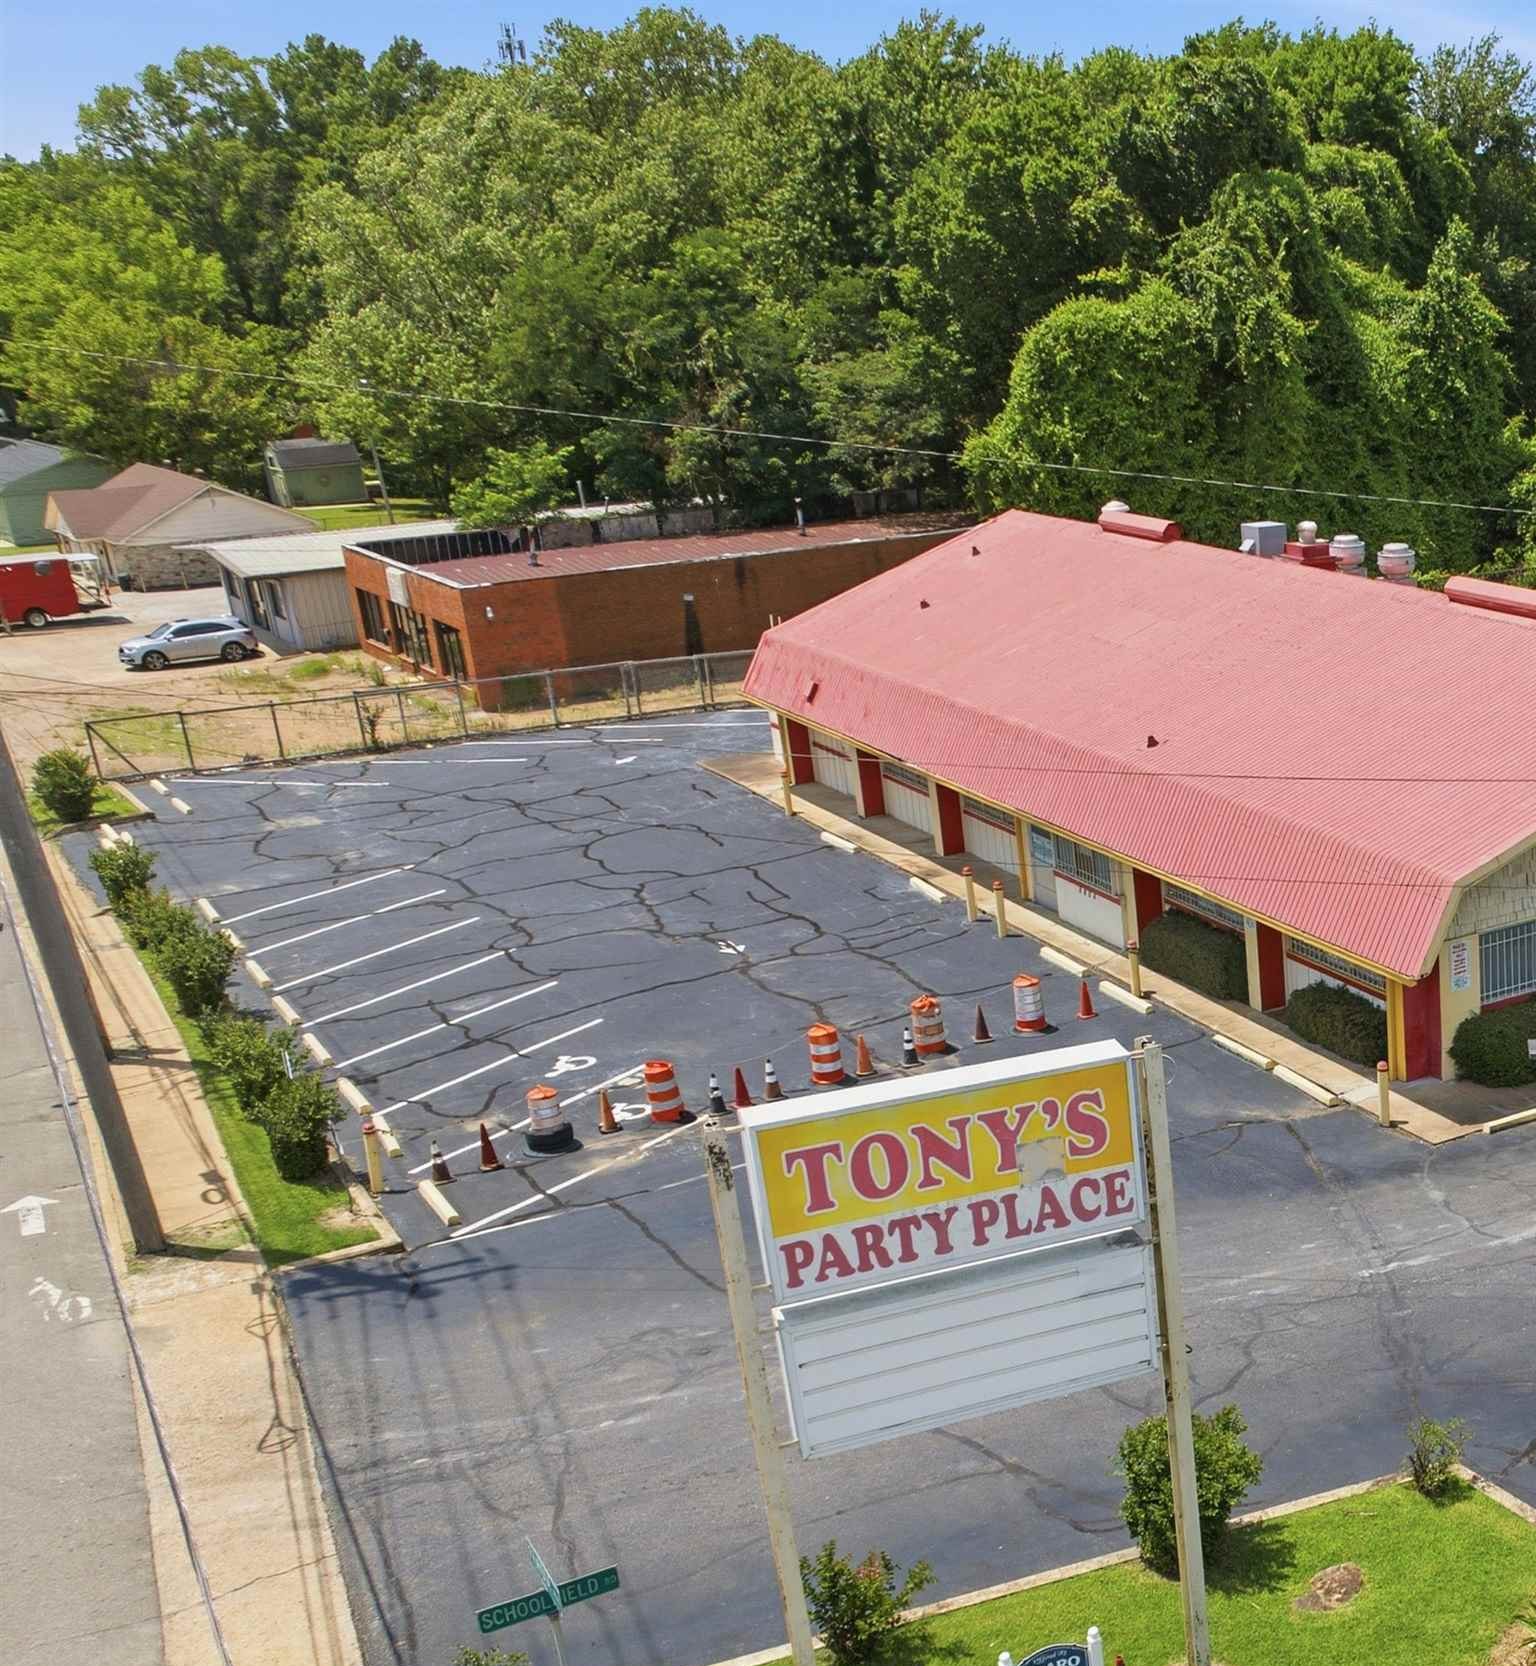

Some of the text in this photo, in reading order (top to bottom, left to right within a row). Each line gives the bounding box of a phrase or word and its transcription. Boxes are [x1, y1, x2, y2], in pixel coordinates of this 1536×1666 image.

[784, 1090, 1109, 1213] TONY'S
[780, 1170, 1134, 1288] PARTY PLACE
[481, 1578, 598, 1629] SCHOOLIELD
